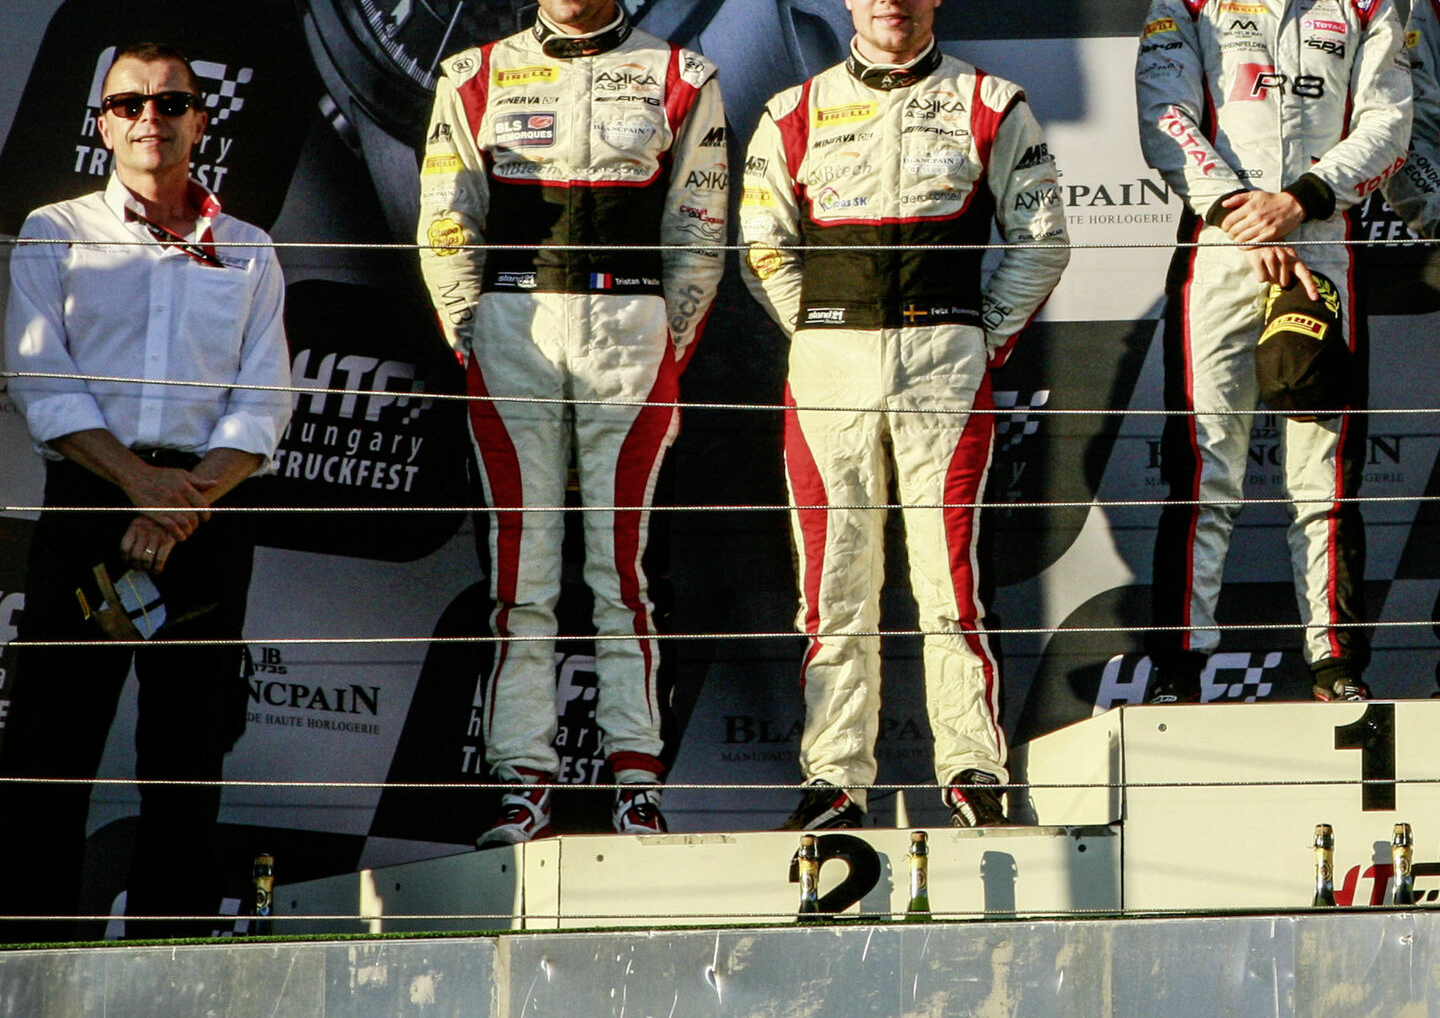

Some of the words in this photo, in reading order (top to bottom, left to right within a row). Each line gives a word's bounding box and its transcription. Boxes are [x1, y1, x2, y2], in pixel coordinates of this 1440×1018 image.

[1314, 21, 1345, 32] TOTAL
[498, 67, 553, 82] PIRELLI
[1250, 73, 1325, 99] R8
[817, 104, 870, 122] PIRELLI
[495, 120, 522, 134] BLS
[496, 130, 553, 143] REMORQUES
[1159, 105, 1217, 178] TOTAL
[1066, 177, 1170, 208] PAIN
[1088, 213, 1173, 224] HORLOGERIE
[265, 713, 304, 728] HAUTE
[307, 716, 381, 736] HORLOGERIE
[1334, 702, 1396, 812] 1
[789, 833, 882, 919] 2
